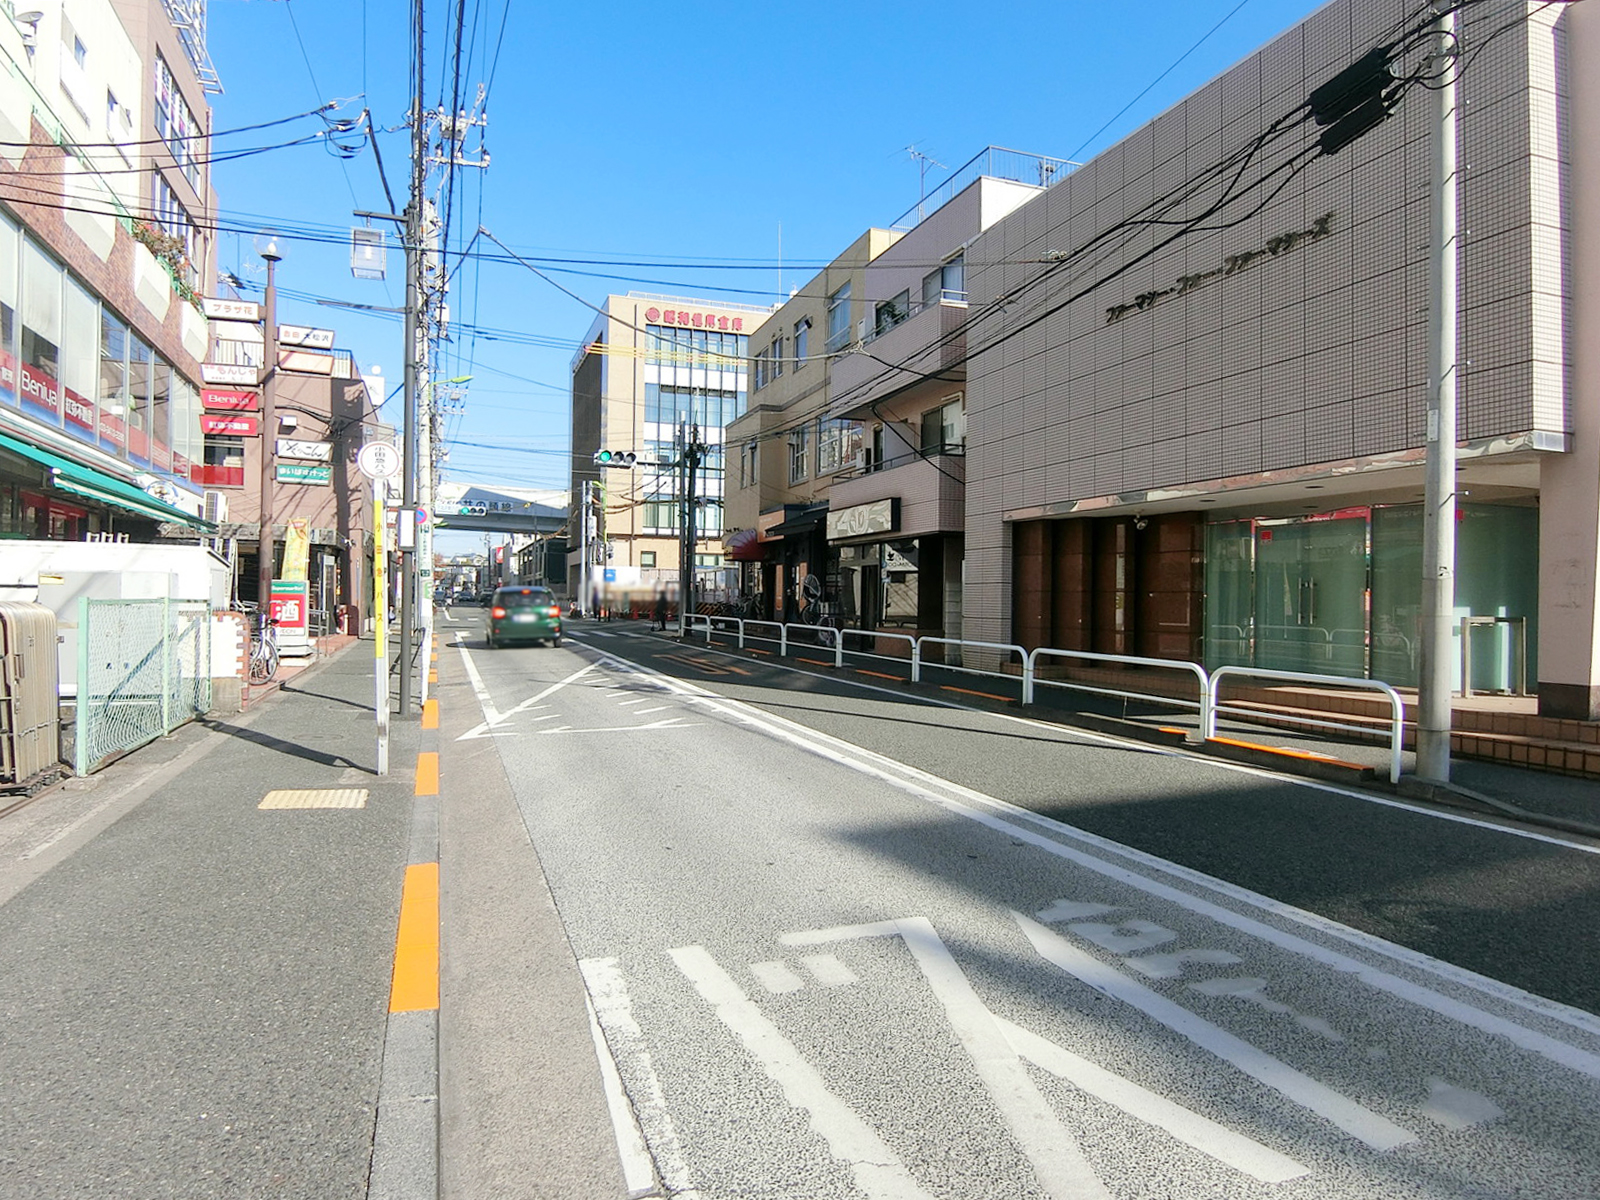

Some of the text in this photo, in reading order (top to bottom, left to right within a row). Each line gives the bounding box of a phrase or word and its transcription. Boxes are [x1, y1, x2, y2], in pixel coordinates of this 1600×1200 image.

[21, 370, 57, 406] Beniya
[279, 466, 330, 479] まいばすけっと
[374, 446, 387, 475] 小田急バス
[375, 522, 384, 624] 小田急バス
[275, 599, 300, 622] 酒
